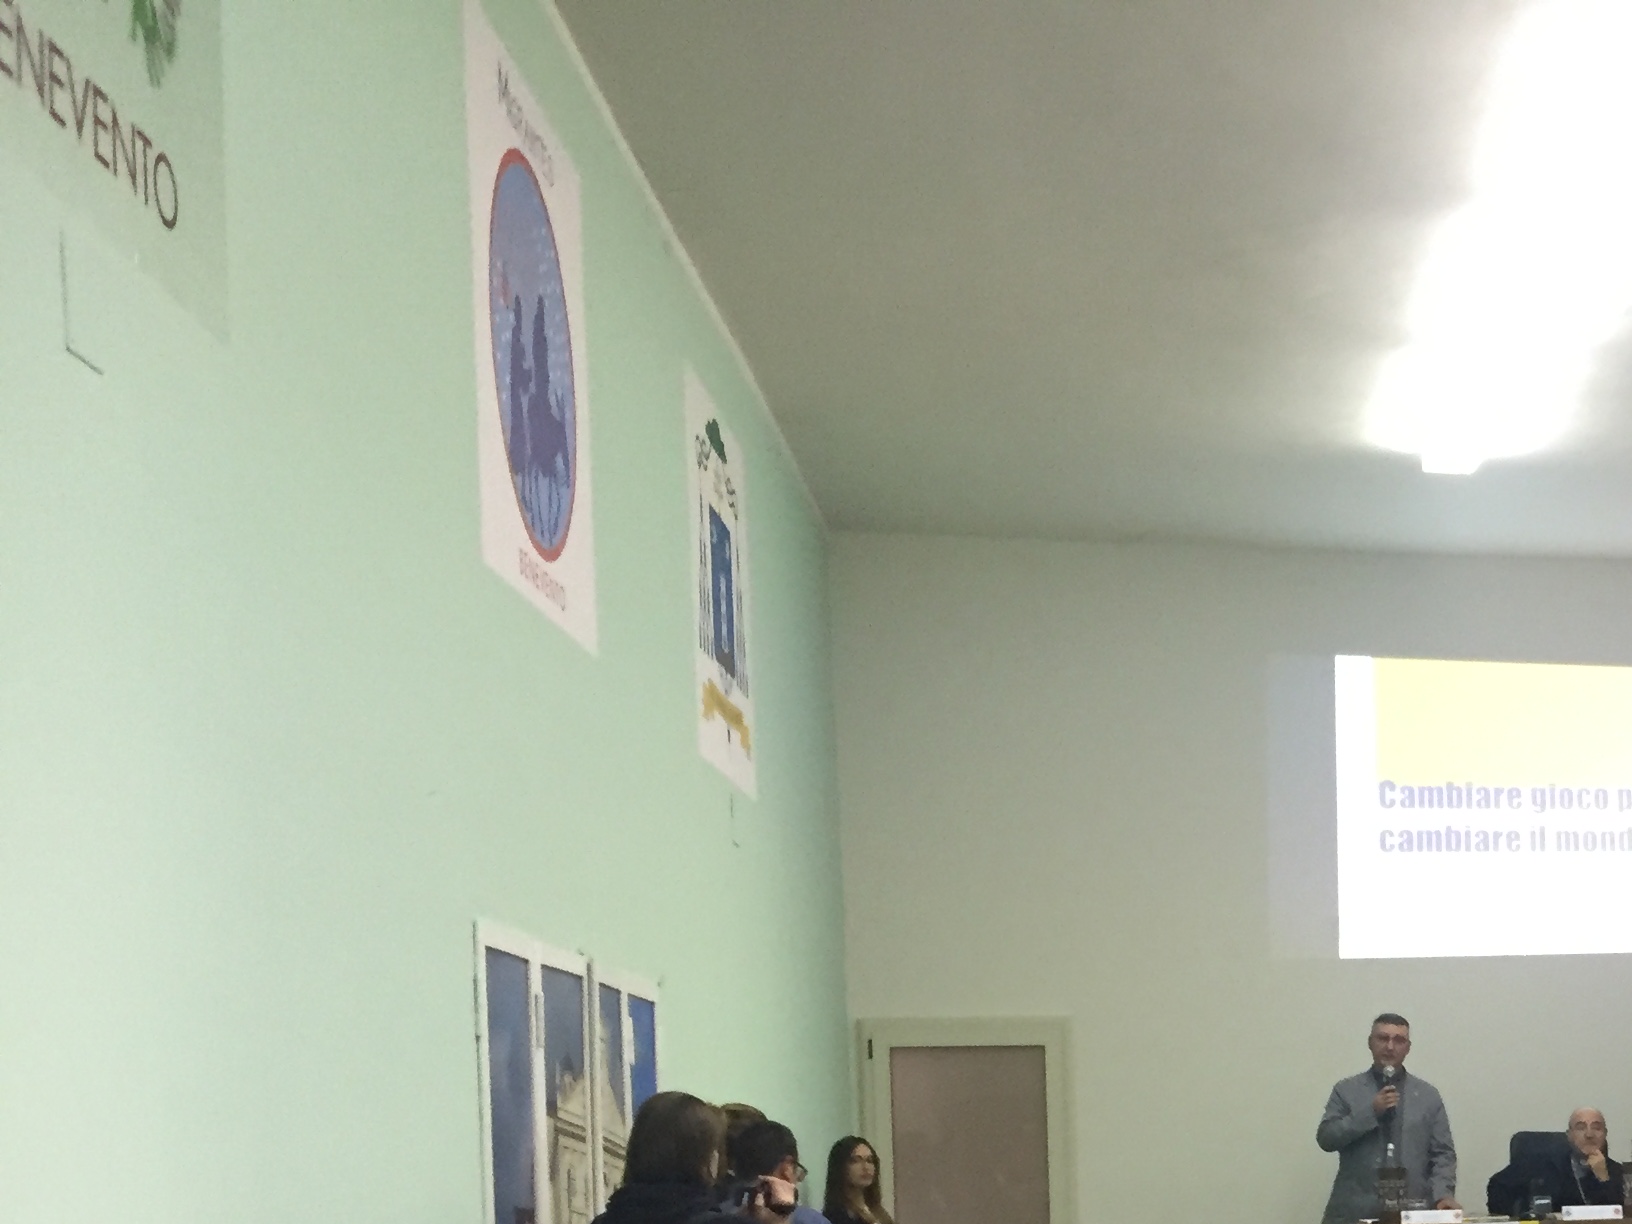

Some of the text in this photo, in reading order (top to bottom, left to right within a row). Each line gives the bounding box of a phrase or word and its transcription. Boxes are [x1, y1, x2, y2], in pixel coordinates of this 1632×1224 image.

[0, 0, 178, 230] ENEVENTO
[1378, 780, 1522, 809] Cambiare
[1531, 783, 1609, 813] gioco
[1379, 825, 1521, 853] cambiare
[1530, 825, 1546, 852] il
